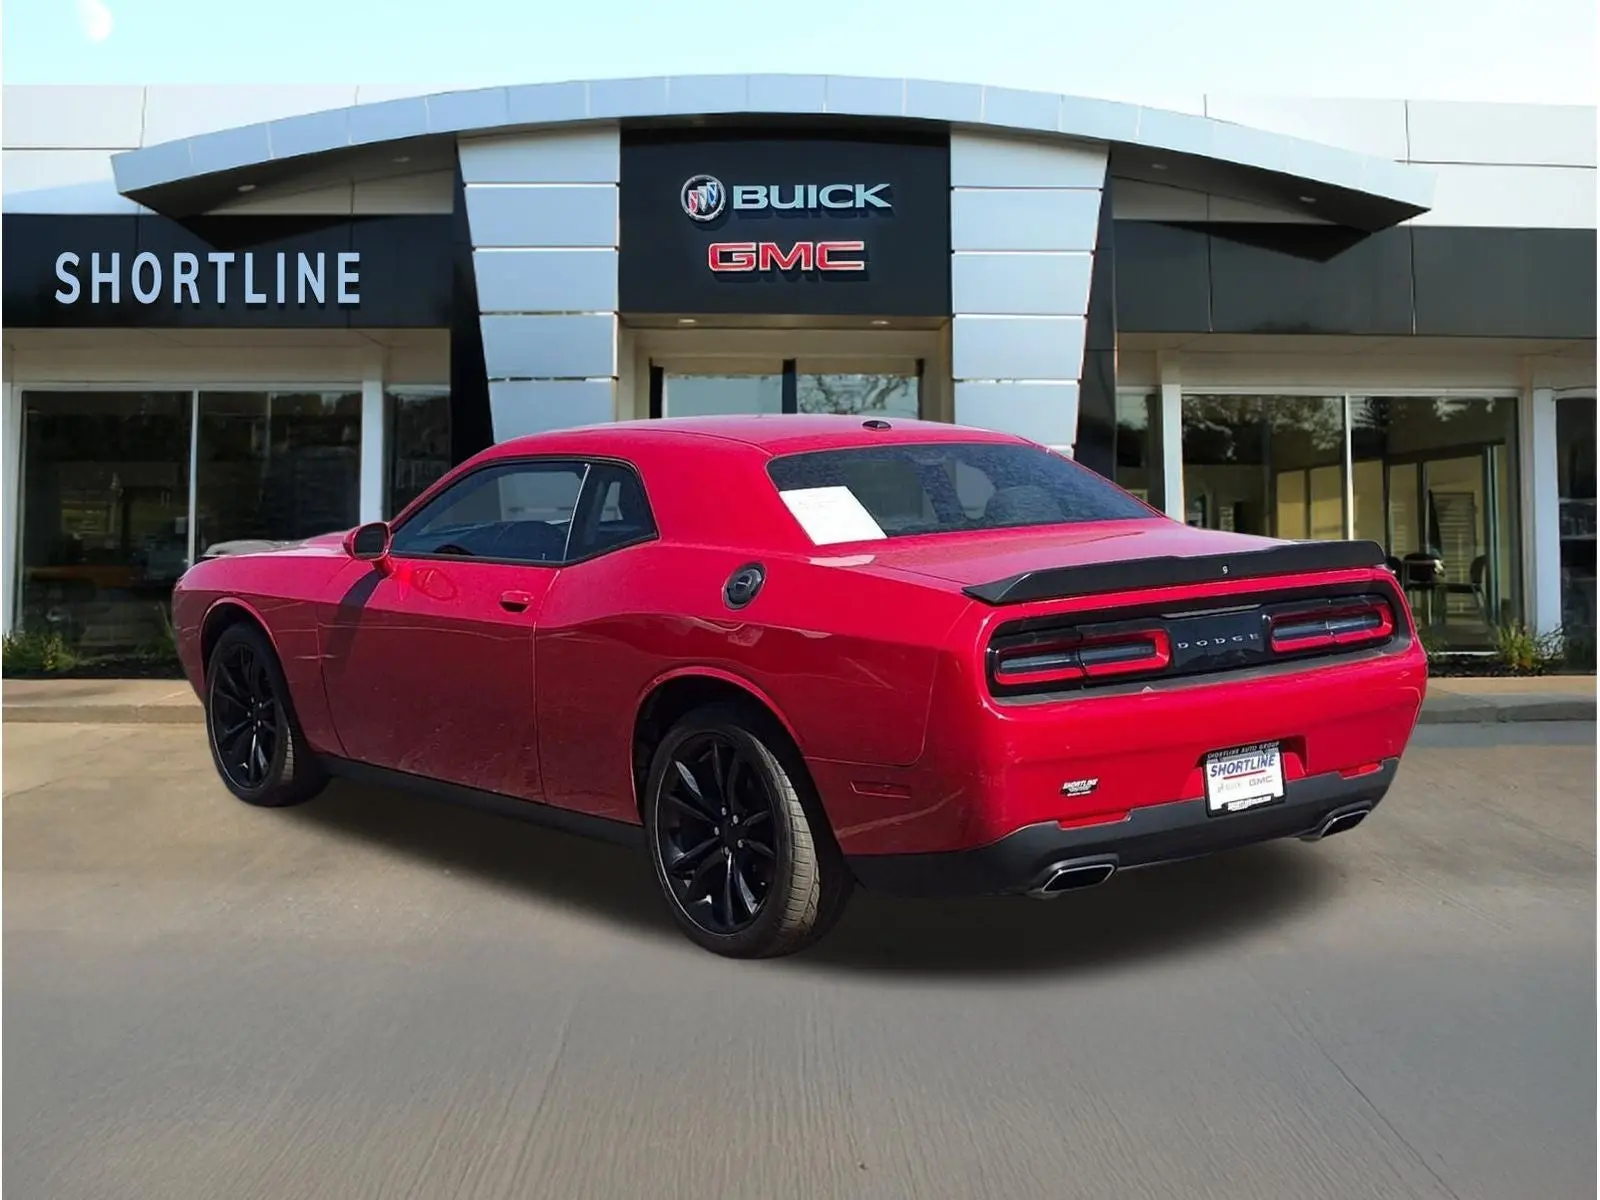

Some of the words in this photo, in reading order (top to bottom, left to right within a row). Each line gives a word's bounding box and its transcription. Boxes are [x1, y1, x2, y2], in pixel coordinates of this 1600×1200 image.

[733, 184, 892, 210] BUICK
[708, 240, 865, 271] GMC
[55, 251, 361, 304] SHORTLINE
[1177, 633, 1260, 649] DODGE
[1240, 745, 1258, 754] AUTO
[1210, 755, 1276, 777] SHORTLINE
[1249, 775, 1273, 787] GMC
